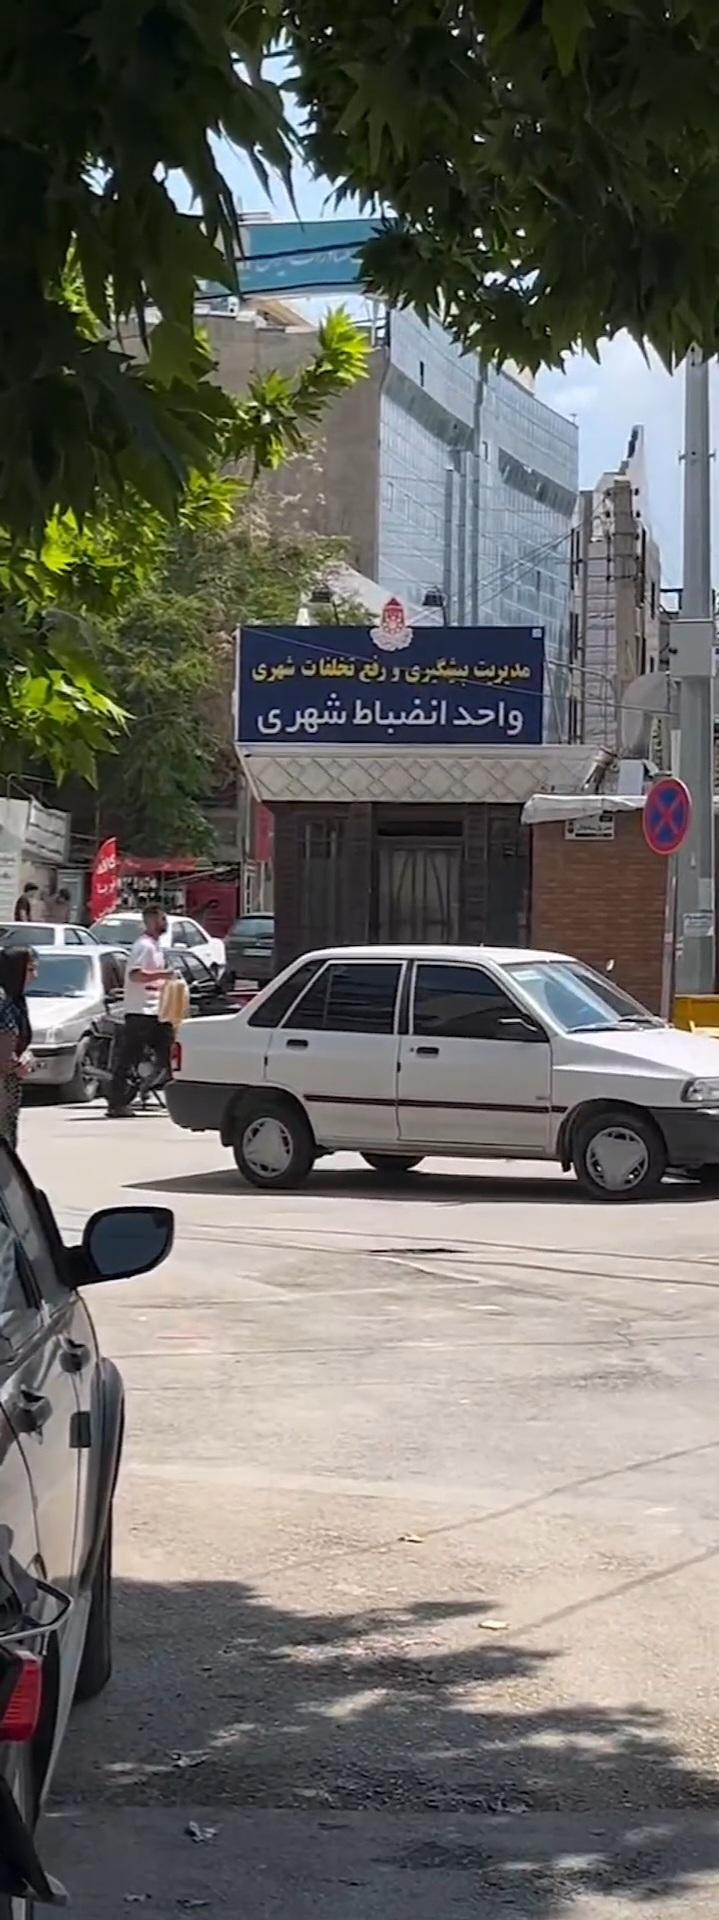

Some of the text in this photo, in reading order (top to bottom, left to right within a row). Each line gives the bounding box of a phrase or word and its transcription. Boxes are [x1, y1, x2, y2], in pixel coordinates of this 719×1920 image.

[252, 655, 531, 686] مدیریت پیشگیری و رفع تخلفات شهری
[257, 693, 523, 735] واحد انضباط شهری
